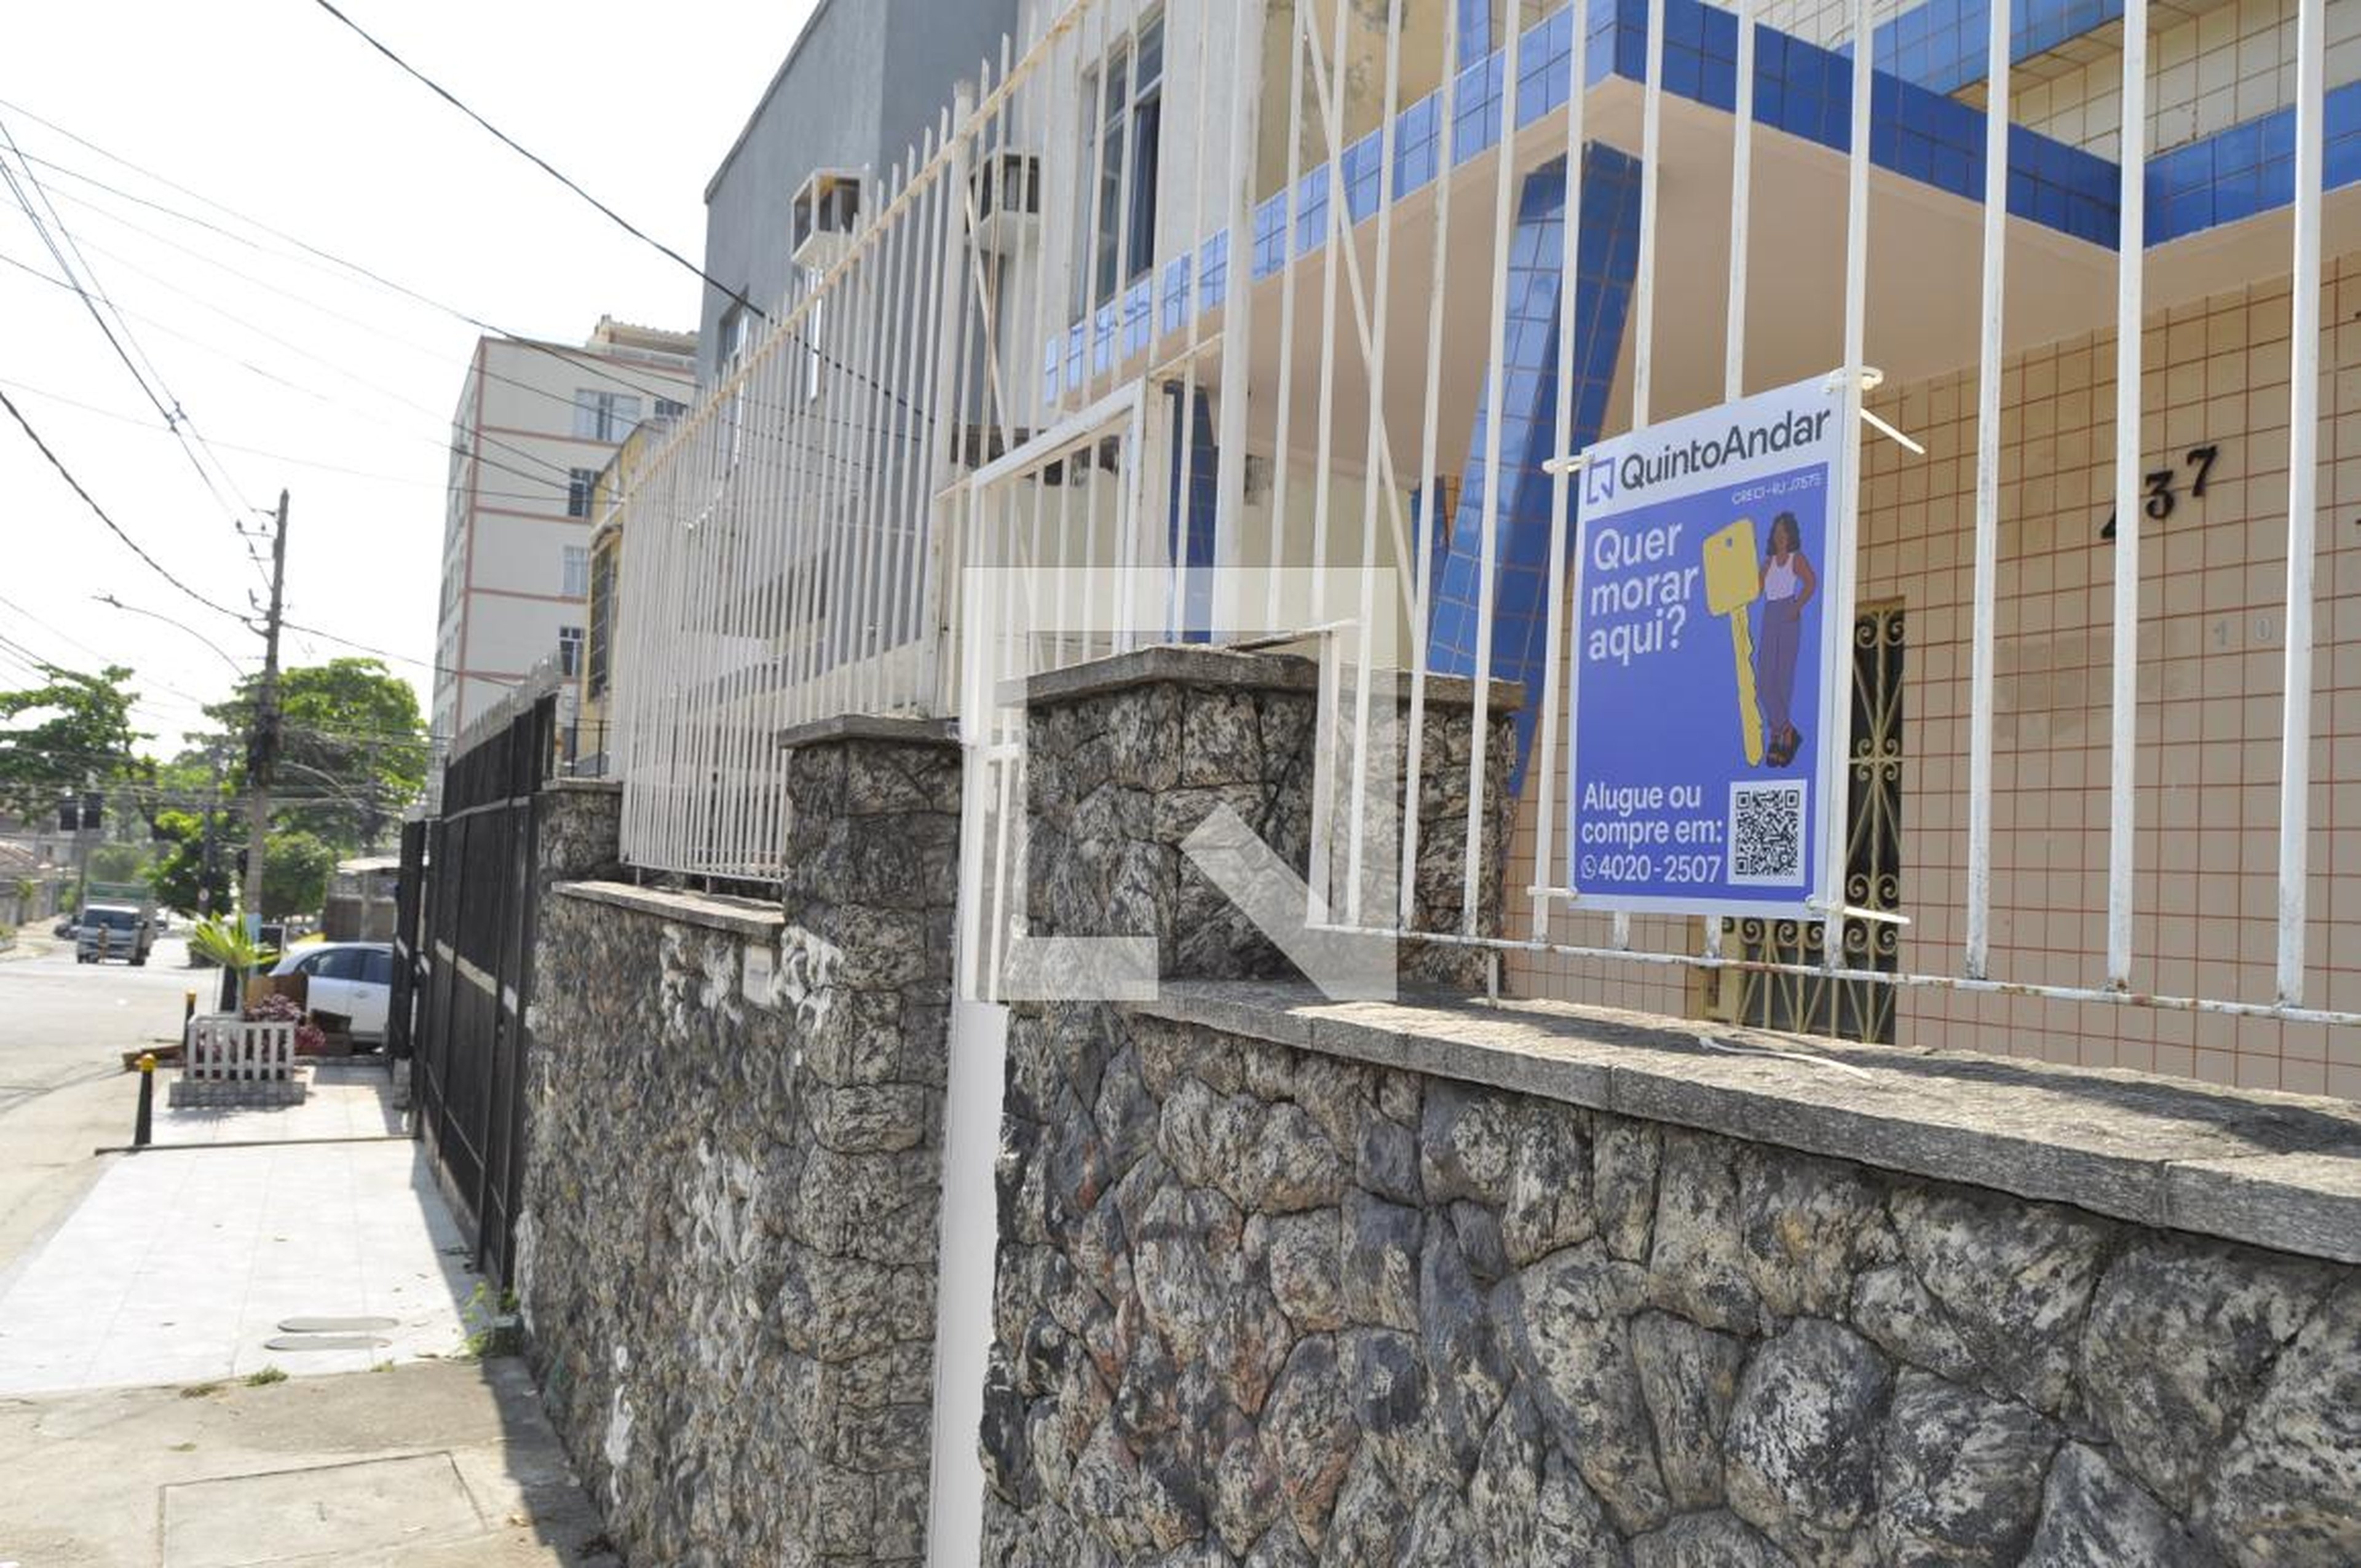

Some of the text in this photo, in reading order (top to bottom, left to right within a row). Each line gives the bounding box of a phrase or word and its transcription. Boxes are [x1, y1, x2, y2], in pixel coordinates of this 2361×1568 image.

[1621, 409, 1831, 490] QuintoAndar
[1594, 523, 1682, 571] Quer
[1591, 566, 1699, 616] morar
[1589, 604, 1686, 666] aqui?
[1582, 782, 1701, 817] Alugue ou
[1581, 819, 1722, 850] compre em:
